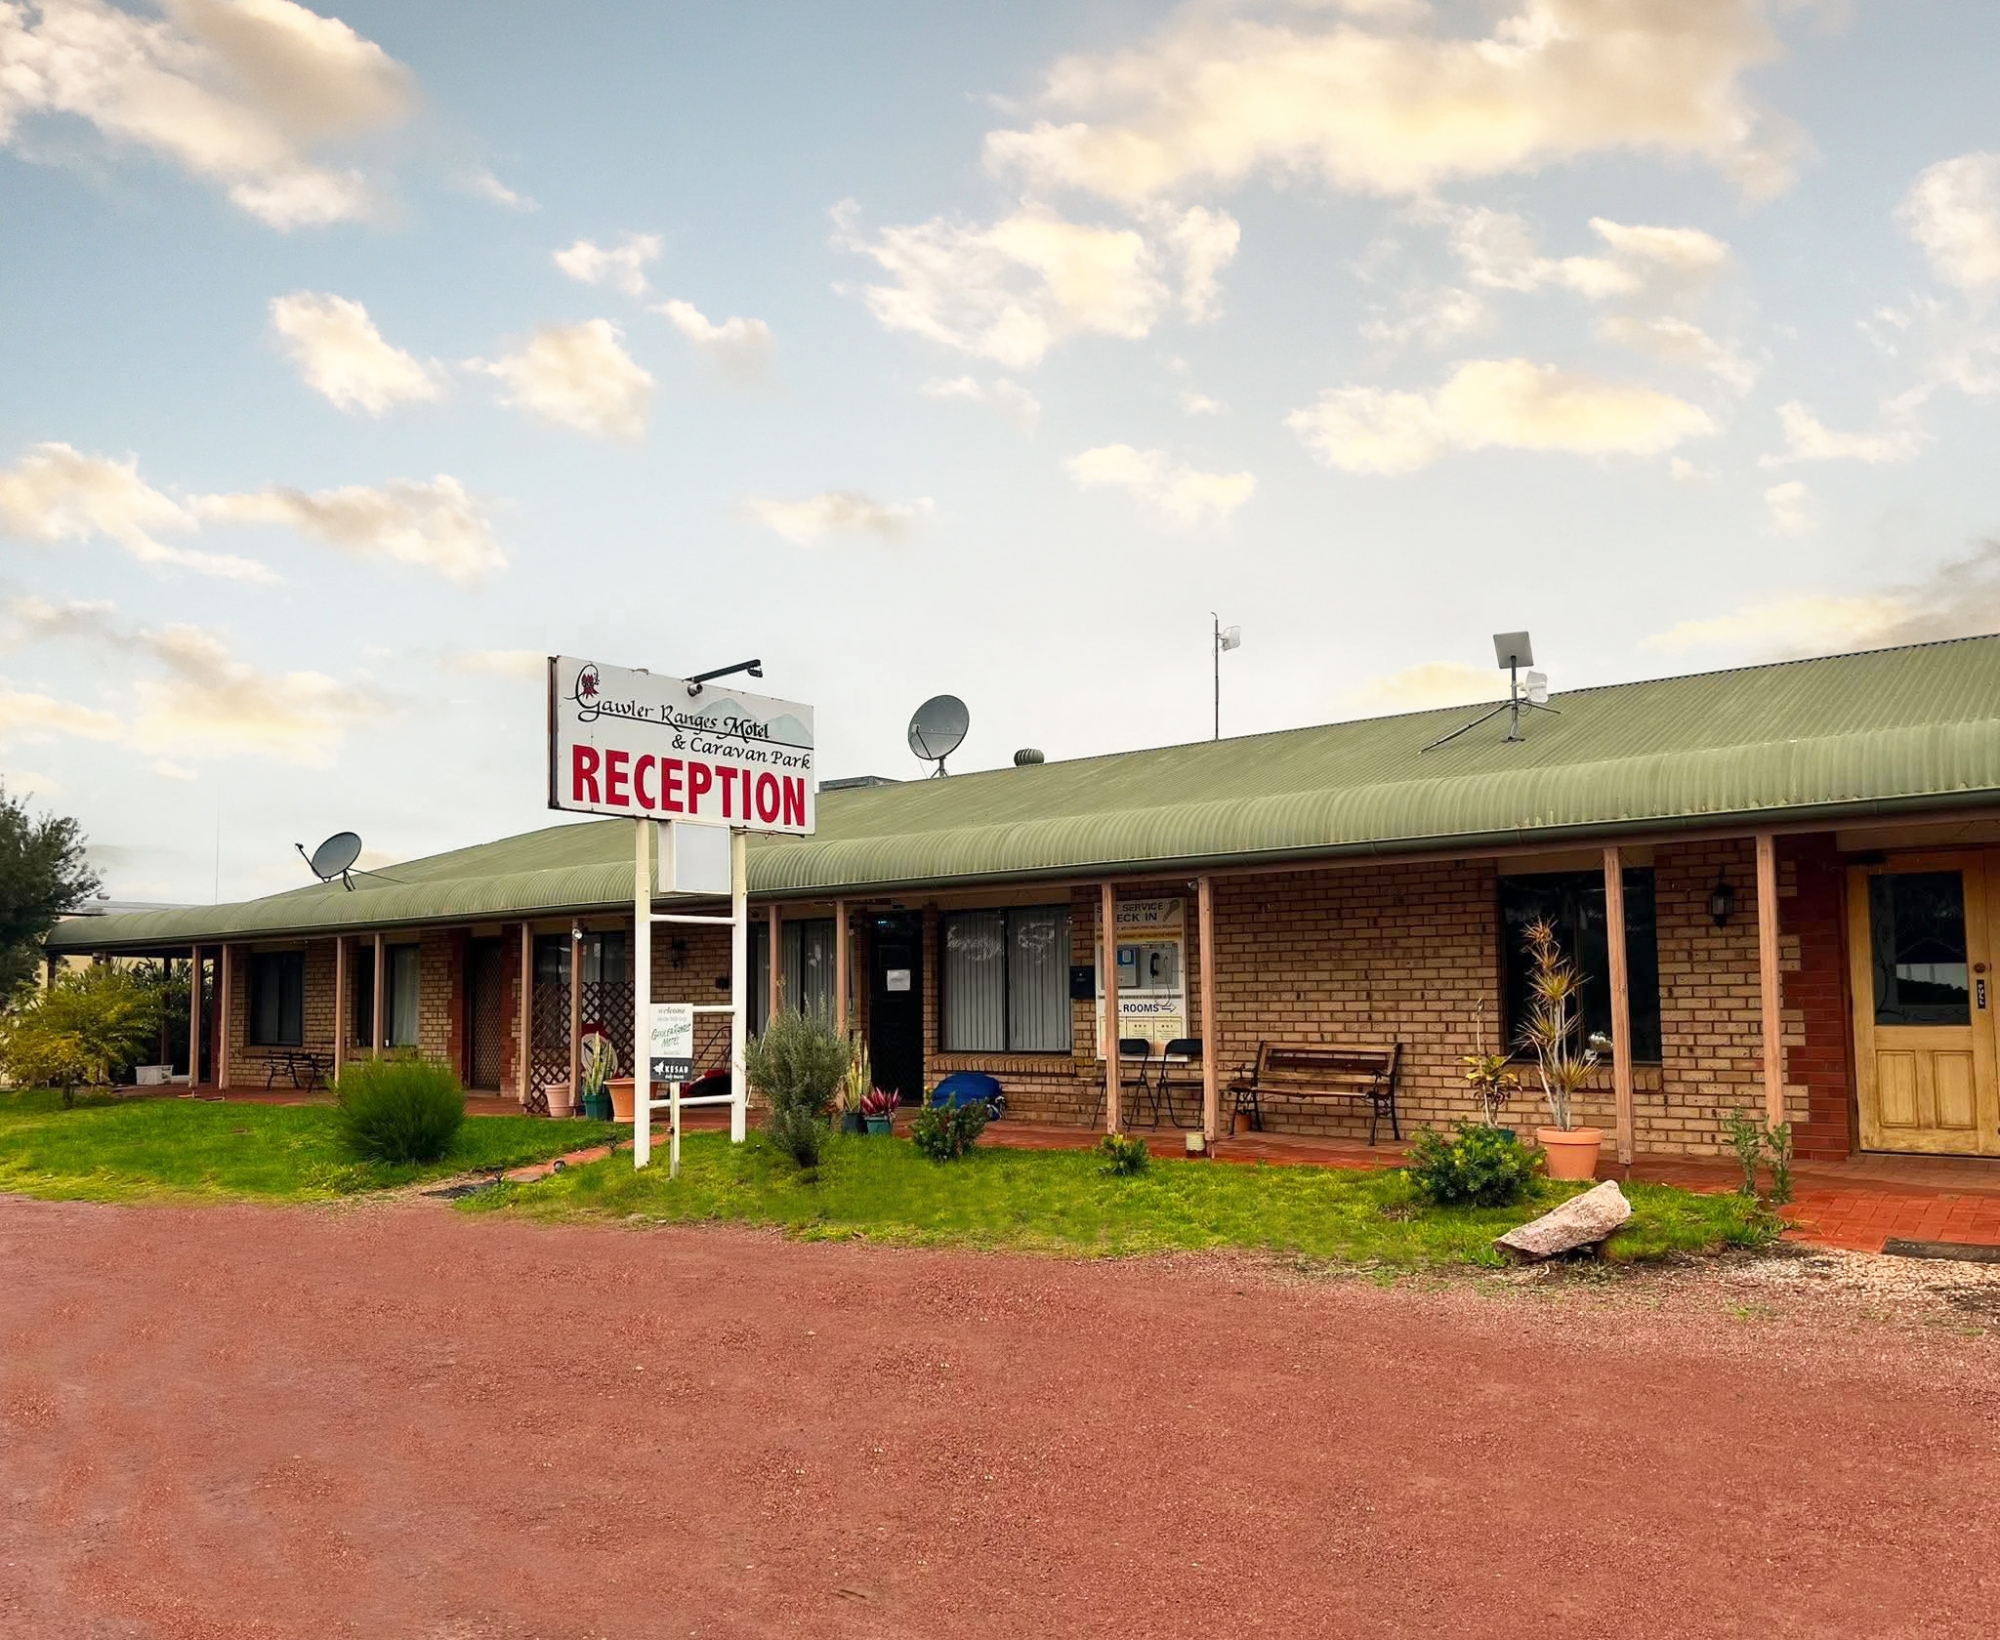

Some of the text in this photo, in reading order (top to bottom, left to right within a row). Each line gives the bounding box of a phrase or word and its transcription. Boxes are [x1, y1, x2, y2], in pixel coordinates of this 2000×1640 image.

[563, 663, 770, 743] Gawler Ranges Motel
[672, 734, 811, 769] & Caravan Park
[572, 744, 806, 827] RECEPTION
[1122, 902, 1164, 912] SERVICE
[1145, 912, 1157, 921] IN
[1123, 1003, 1160, 1013] ROOMS
[664, 1065, 689, 1073] KESAB
